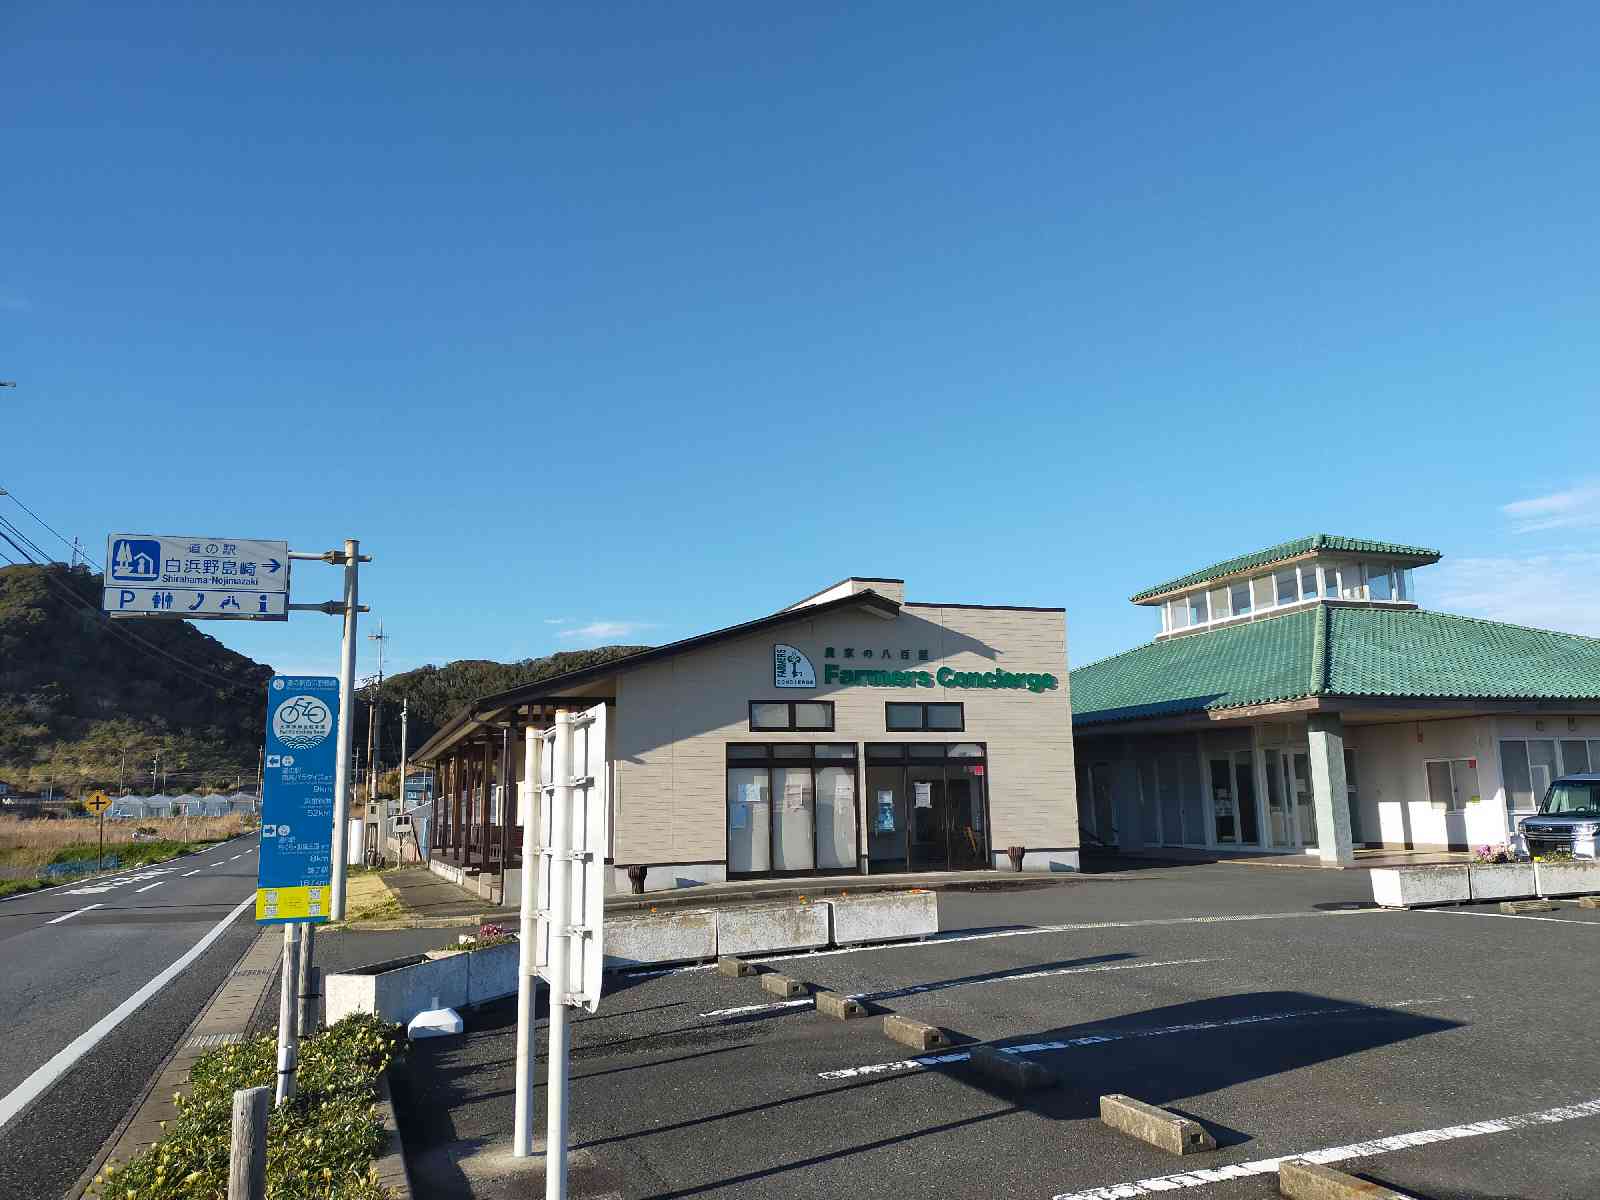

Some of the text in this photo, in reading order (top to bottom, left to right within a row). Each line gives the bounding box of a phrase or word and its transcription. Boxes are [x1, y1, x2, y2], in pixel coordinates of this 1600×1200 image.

[187, 544, 236, 555] 道の駅
[165, 558, 257, 576] 白浜野島崎
[119, 590, 135, 608] P
[824, 664, 1059, 693] Farmers Concierge
